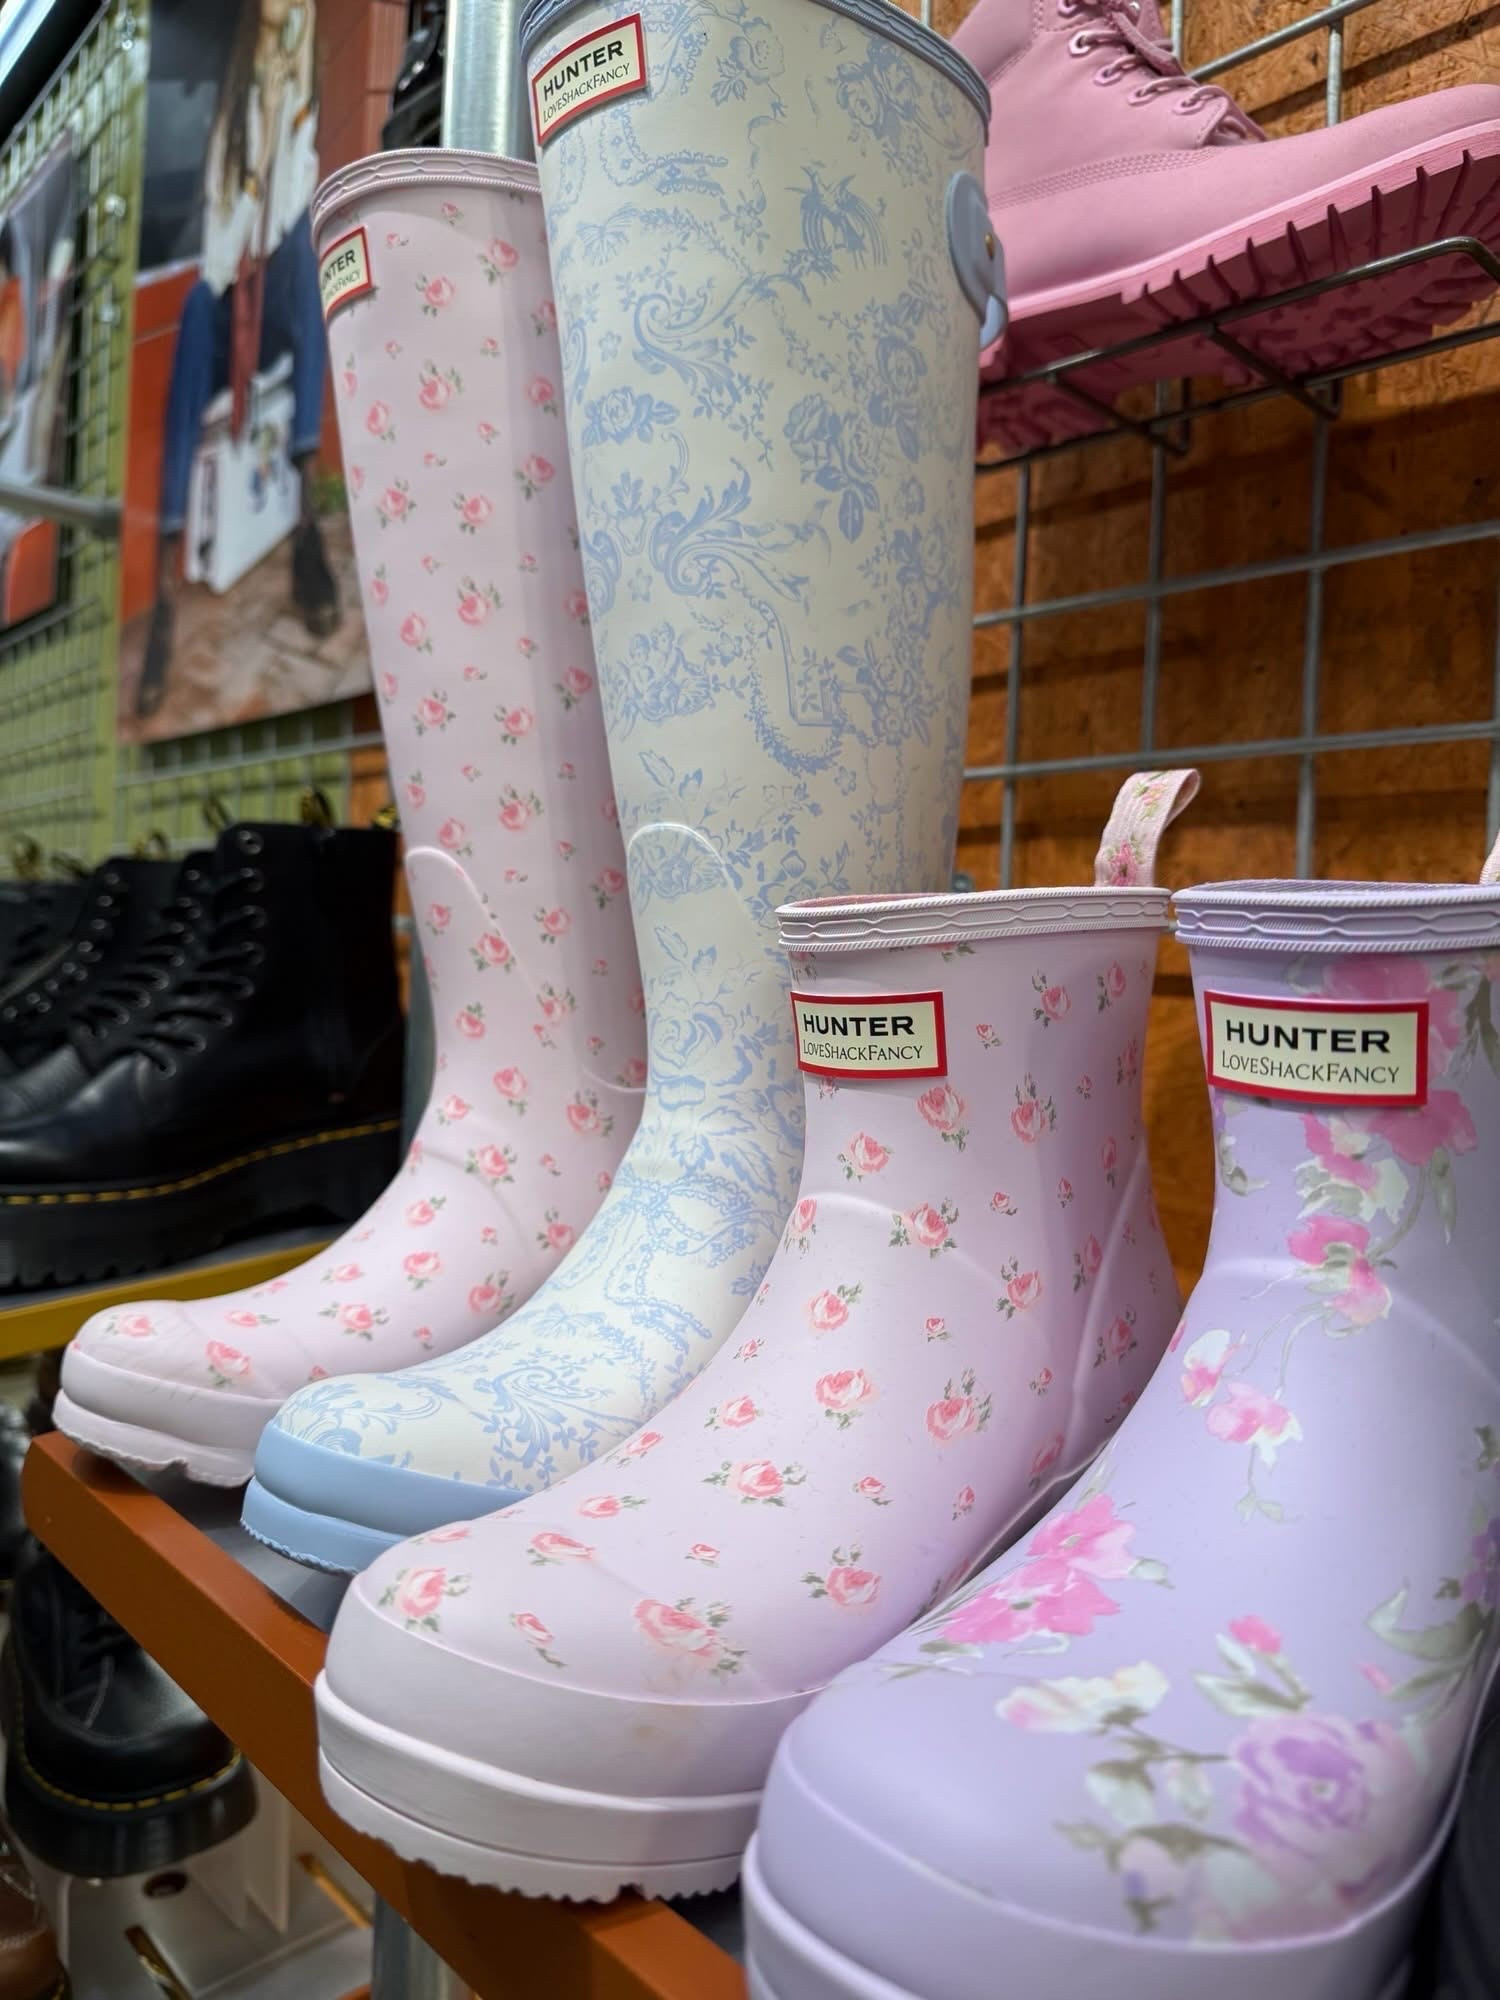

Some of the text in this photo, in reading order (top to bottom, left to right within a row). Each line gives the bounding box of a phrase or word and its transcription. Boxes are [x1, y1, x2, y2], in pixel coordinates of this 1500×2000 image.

[543, 40, 624, 101] HUNTER
[321, 249, 356, 290] NTER
[803, 1013, 915, 1036] HUNTER
[1226, 1019, 1391, 1053] HUNTER
[803, 1039, 923, 1061] LOVESHACKFANCY
[1222, 1050, 1400, 1084] LOVESHACKFANCY
